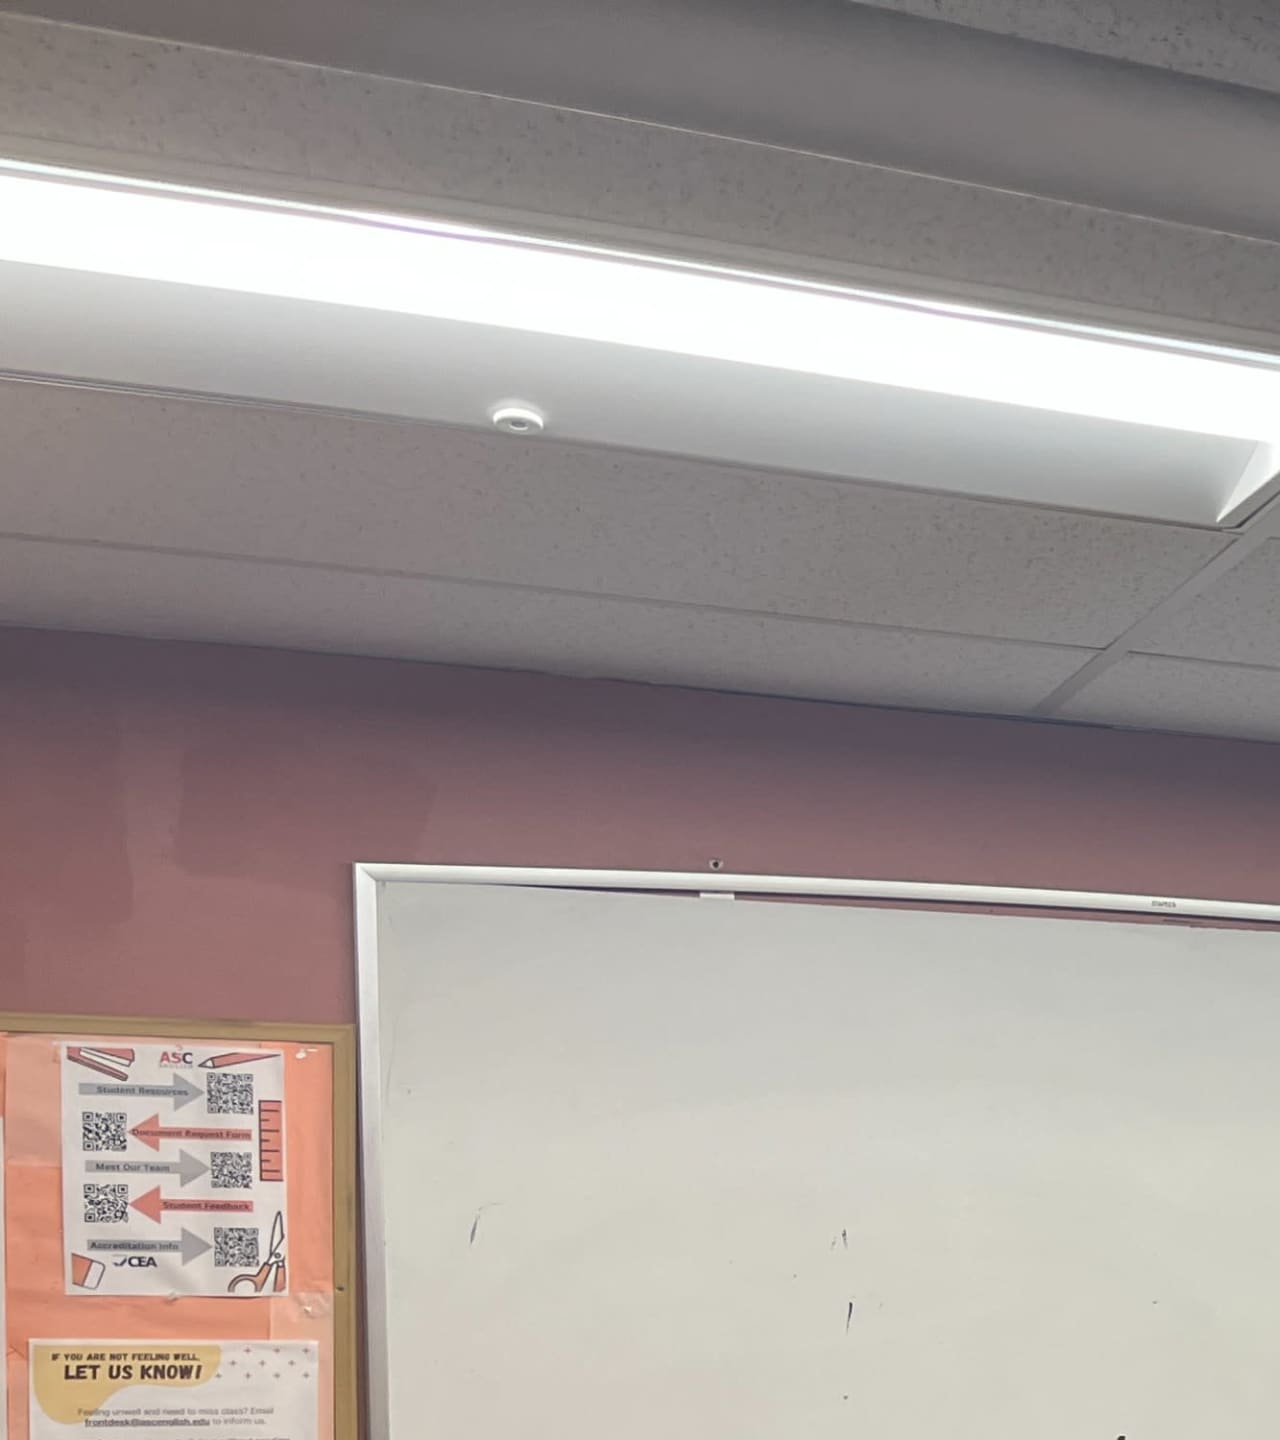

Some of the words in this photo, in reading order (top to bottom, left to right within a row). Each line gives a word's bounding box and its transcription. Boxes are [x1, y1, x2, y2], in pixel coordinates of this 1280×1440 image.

[160, 1051, 193, 1064] ASC
[97, 1086, 135, 1095] Student
[138, 1087, 189, 1096] Resources
[132, 1128, 182, 1137] Document
[185, 1130, 224, 1140] Request
[226, 1131, 251, 1139] Form
[144, 1164, 170, 1172] Team
[163, 1202, 201, 1210] Student
[204, 1202, 249, 1210] Feedback
[90, 1242, 157, 1250] Accreditation
[128, 1256, 158, 1267] CEA
[51, 1353, 60, 1361] IF
[64, 1353, 83, 1361] YOU
[86, 1353, 106, 1361] ARE
[109, 1353, 128, 1361] NOT
[131, 1353, 170, 1361] FEELING
[64, 1365, 101, 1380] LET
[108, 1365, 133, 1380] US
[140, 1364, 203, 1380] KNOW!
